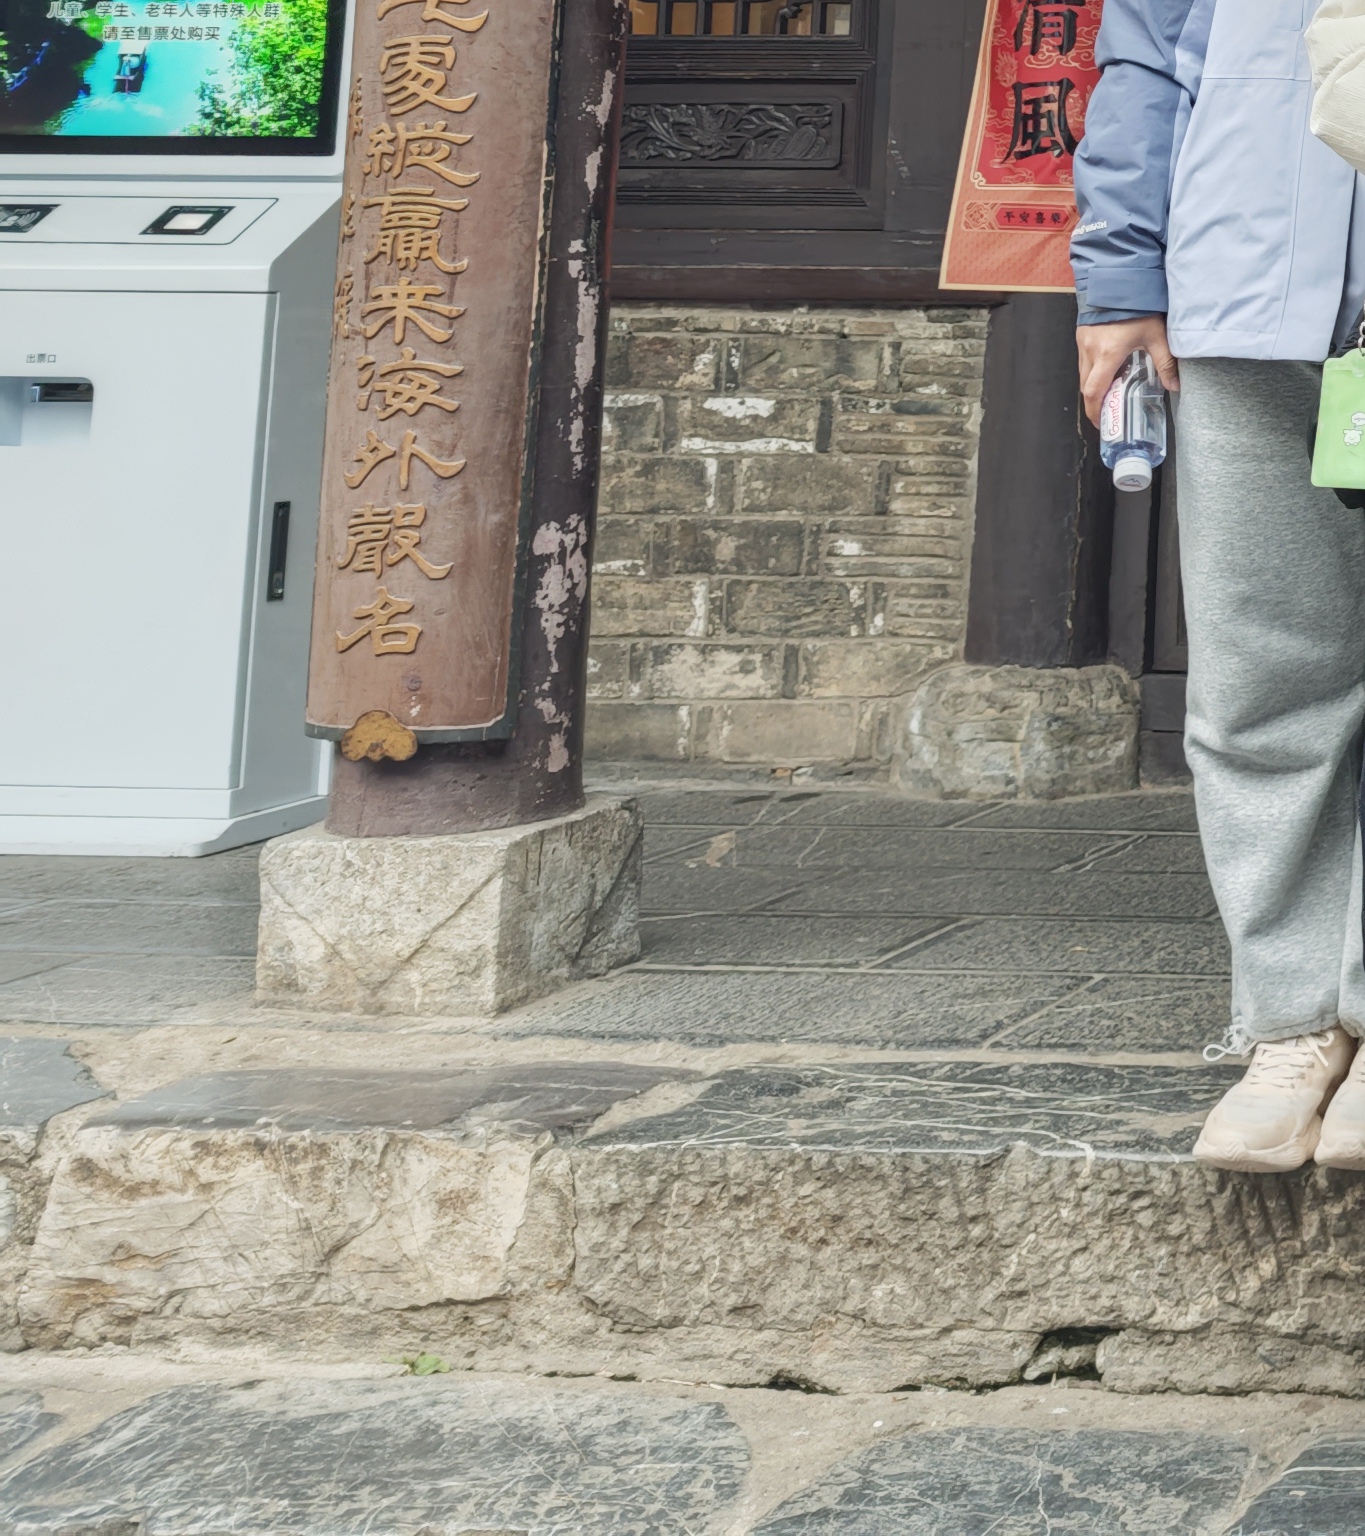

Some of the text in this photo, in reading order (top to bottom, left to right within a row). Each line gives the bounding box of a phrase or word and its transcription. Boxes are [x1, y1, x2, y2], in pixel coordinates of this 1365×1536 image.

[47, 2, 281, 19] 儿童、学生、老年人等特殊人群
[103, 25, 221, 42] 请至售票处购买
[25, 353, 57, 364] 出票口
